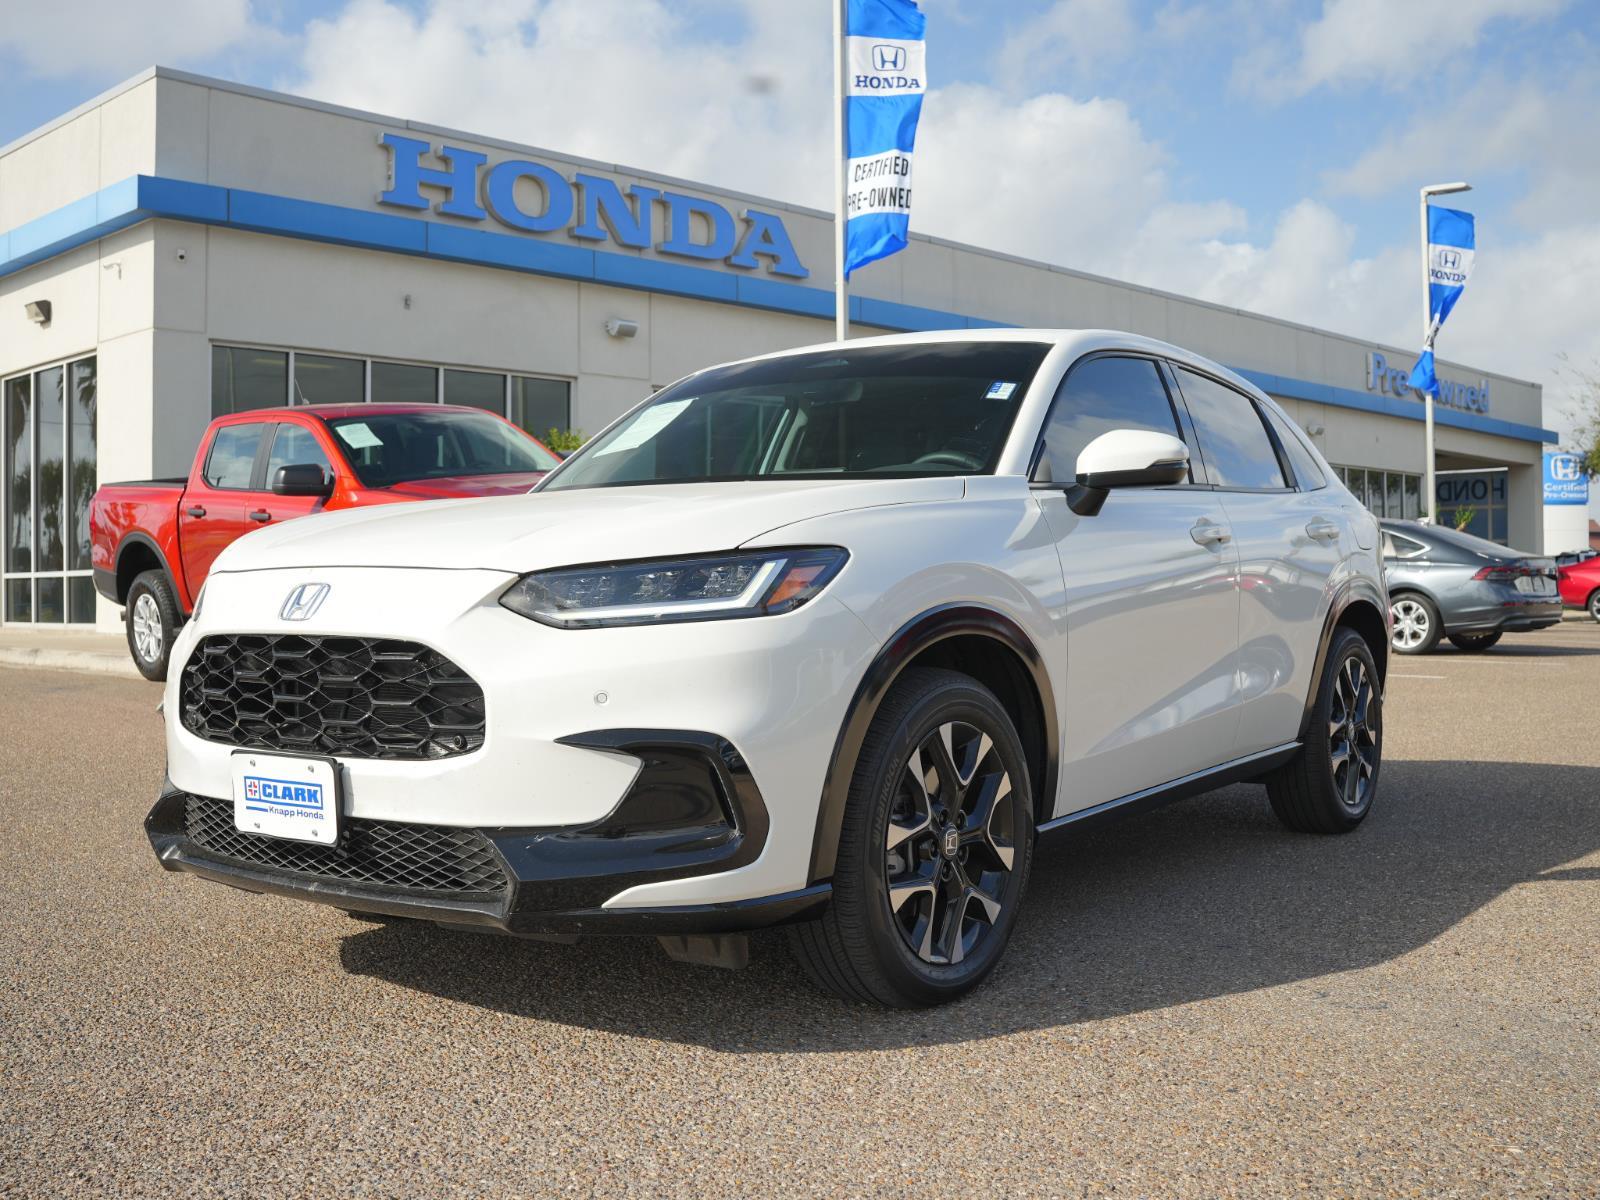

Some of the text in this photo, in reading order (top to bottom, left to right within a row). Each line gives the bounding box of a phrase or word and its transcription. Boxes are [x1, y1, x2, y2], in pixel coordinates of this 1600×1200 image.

[854, 75, 921, 89] HONDA
[854, 156, 909, 183] CERTIFIED
[377, 132, 810, 279] HONDA
[1368, 352, 1489, 413] Prewned
[262, 783, 319, 803] CLARK
[268, 805, 324, 820] Knapp Honda
